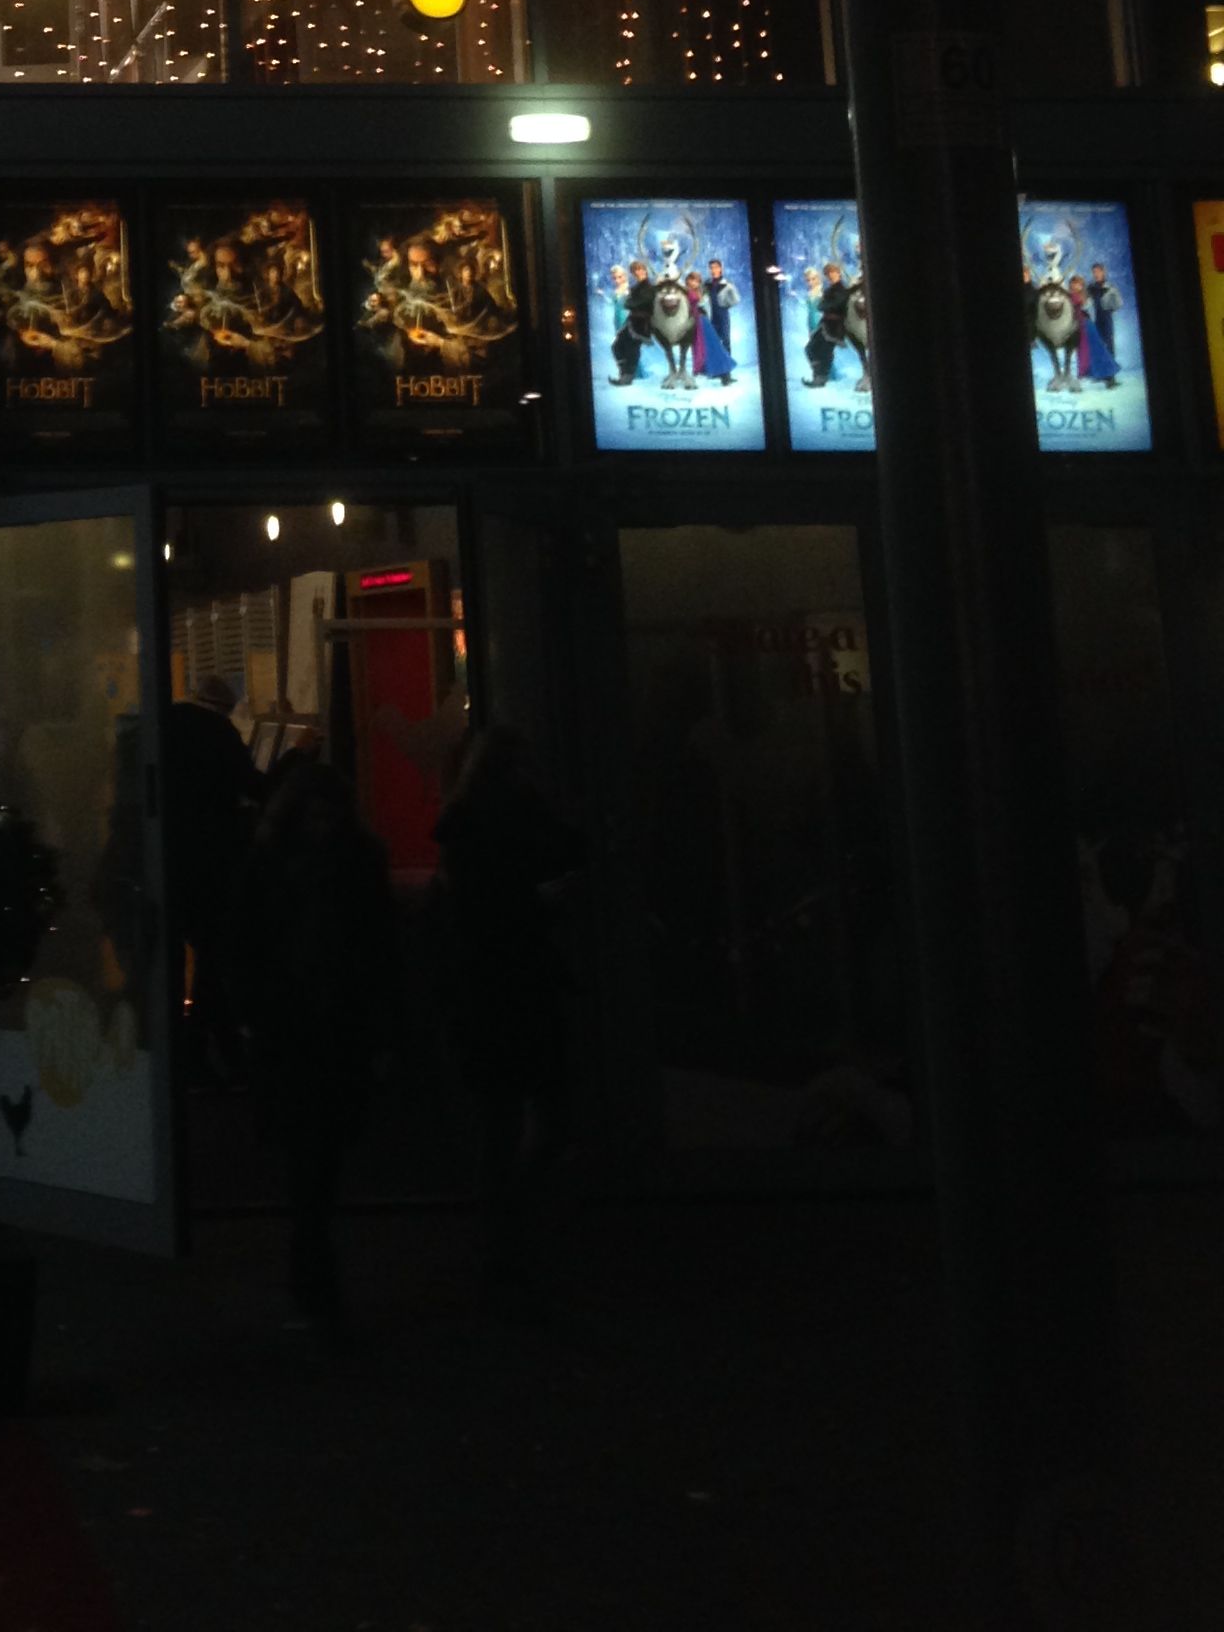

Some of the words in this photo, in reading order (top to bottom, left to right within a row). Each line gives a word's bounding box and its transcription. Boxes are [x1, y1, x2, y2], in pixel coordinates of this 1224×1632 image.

[627, 404, 731, 431] FROZEN
[820, 407, 874, 432] FRO
[1034, 409, 1116, 431] ROZEN
